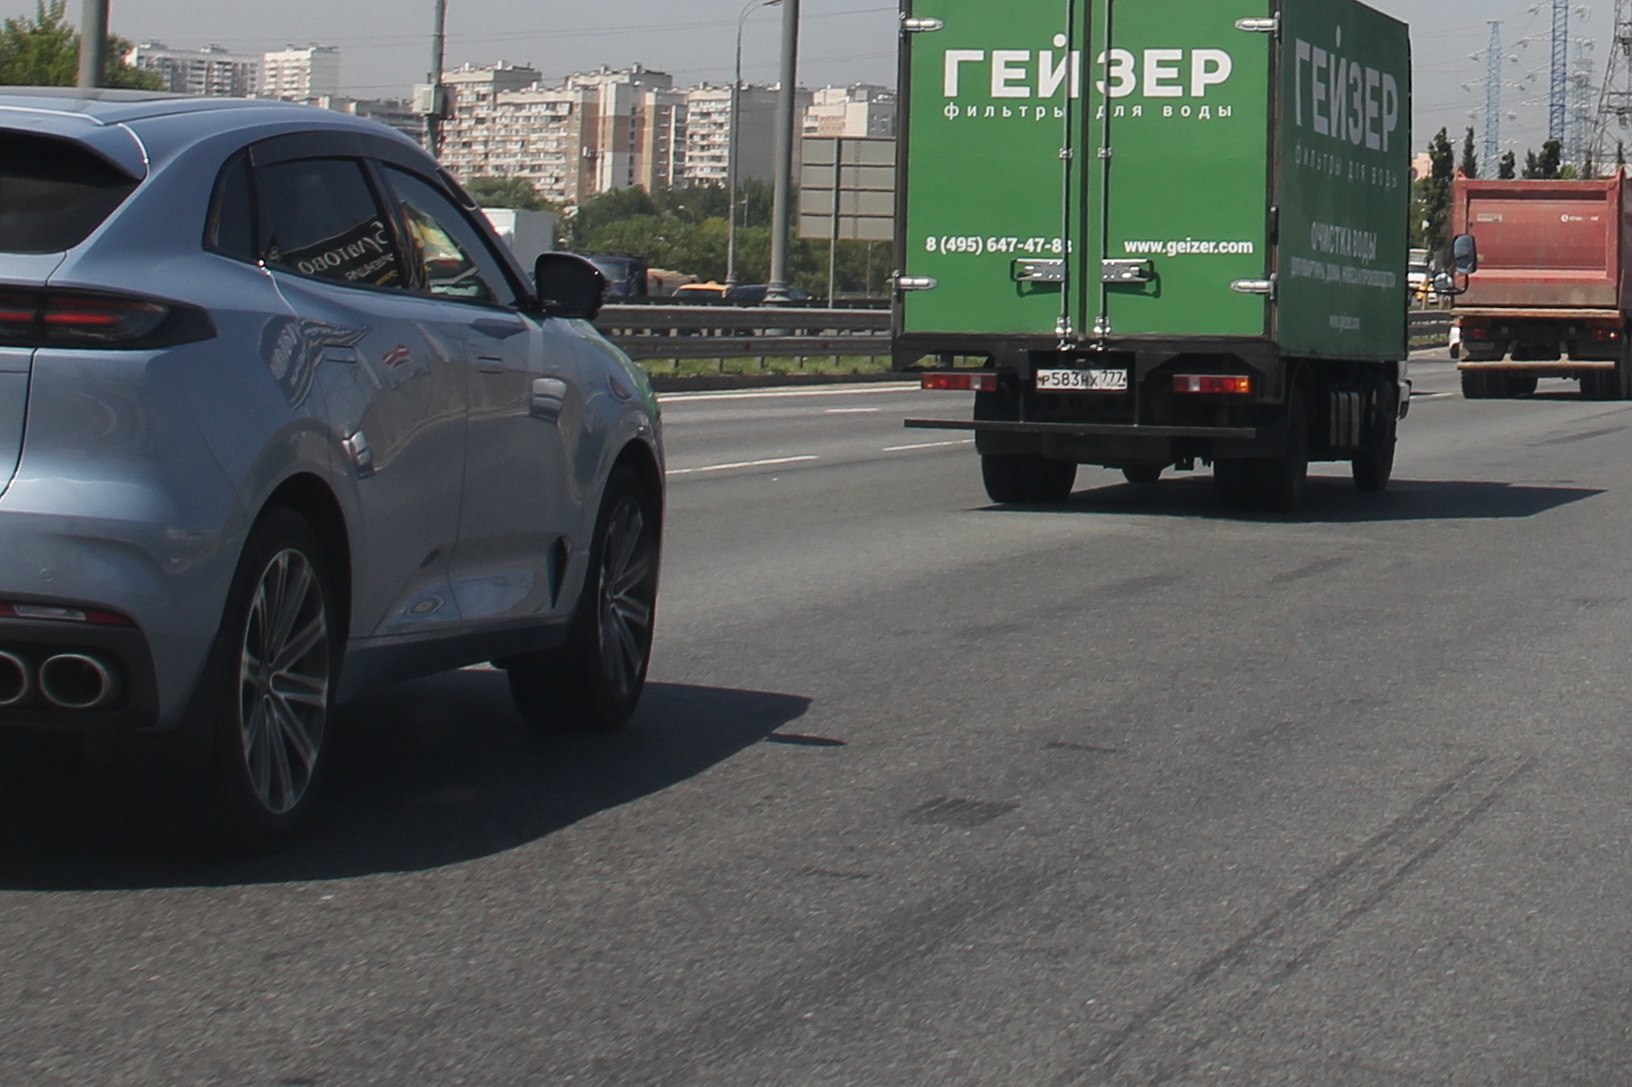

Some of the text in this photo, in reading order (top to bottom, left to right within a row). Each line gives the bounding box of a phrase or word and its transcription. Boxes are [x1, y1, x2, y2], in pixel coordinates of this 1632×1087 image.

[943, 33, 1233, 98] ГЕЙЗЕР
[1295, 25, 1399, 153] ГЕЙЗЕР
[1163, 105, 1232, 119] воды
[925, 237, 937, 252] 8
[940, 236, 983, 255] (495)
[1124, 237, 1253, 256] www.geizer.com
